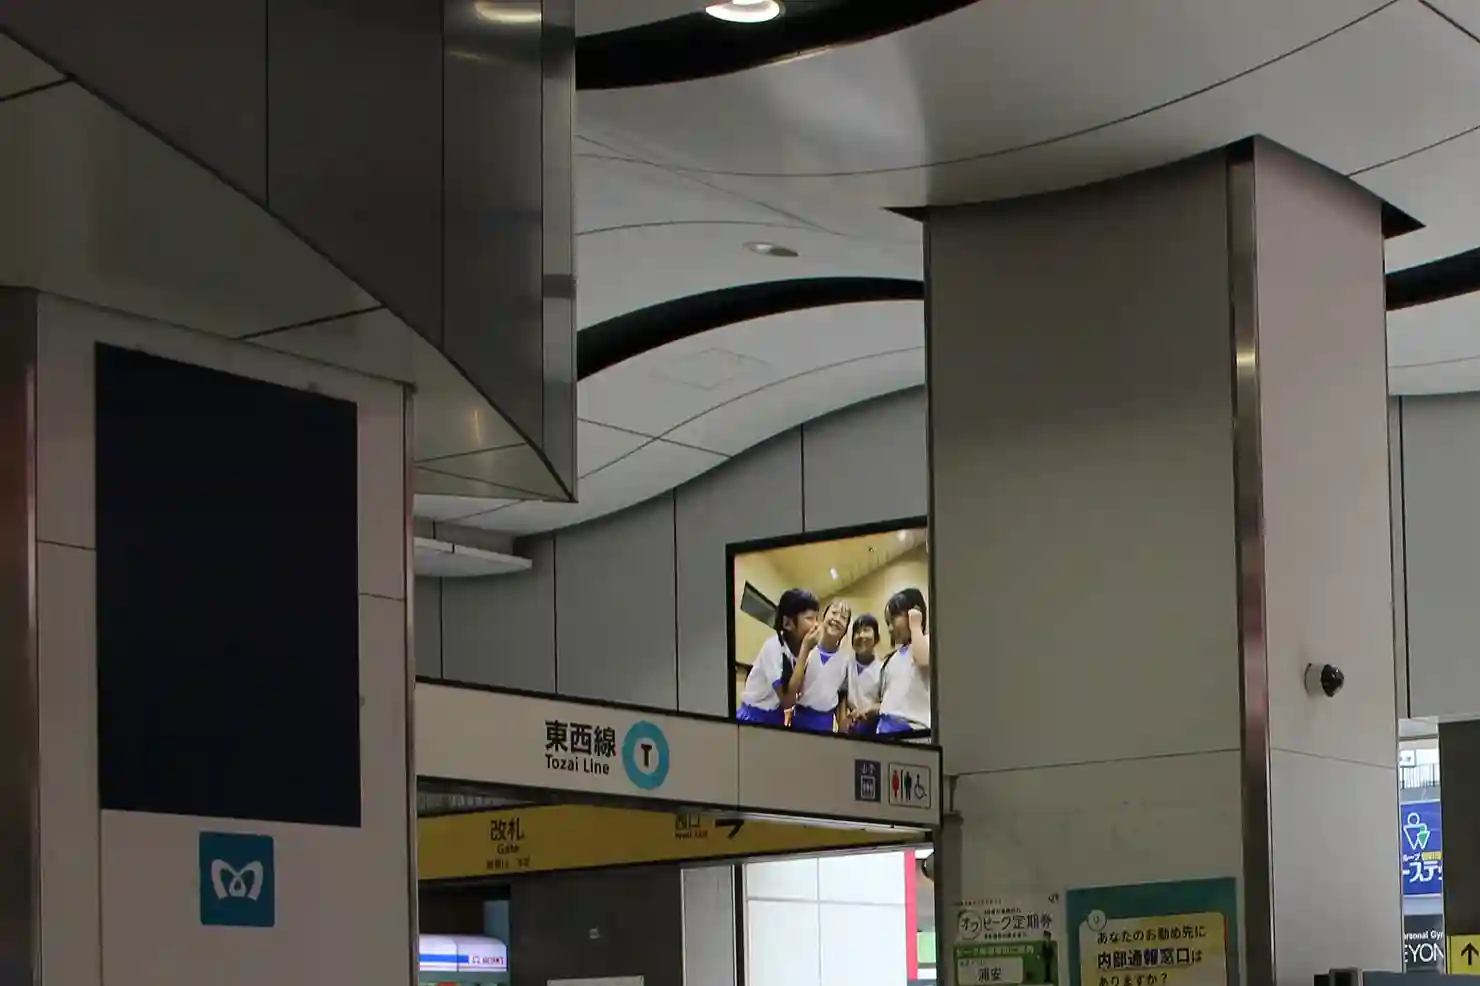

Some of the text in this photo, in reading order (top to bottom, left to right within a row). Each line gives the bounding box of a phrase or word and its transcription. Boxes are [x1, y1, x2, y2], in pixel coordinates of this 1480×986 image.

[545, 720, 617, 758] 東西線
[545, 753, 610, 775] Tozai Line
[641, 743, 653, 769] T
[490, 817, 525, 842] 改札
[1097, 925, 1207, 944] あなたのお勤め先に
[1097, 948, 1203, 970] 内部通報窓口は
